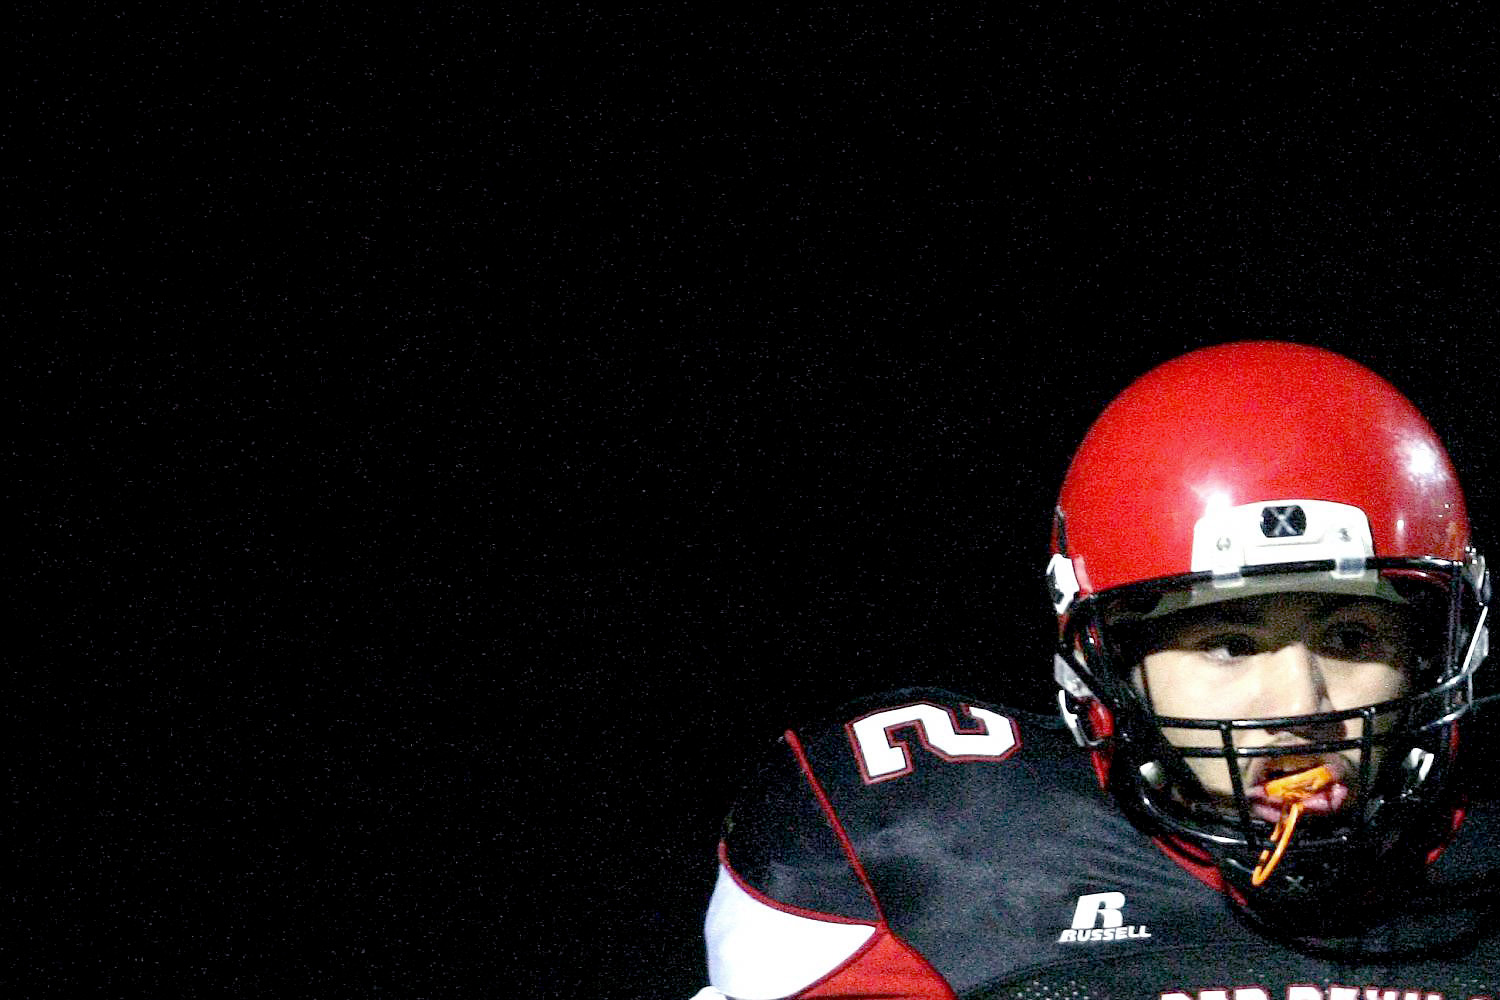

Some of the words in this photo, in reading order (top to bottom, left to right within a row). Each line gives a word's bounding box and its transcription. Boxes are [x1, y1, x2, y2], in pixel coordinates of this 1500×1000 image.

[845, 700, 1023, 785] 2
[1070, 891, 1126, 929] R
[1057, 925, 1152, 942] RUSSELL
